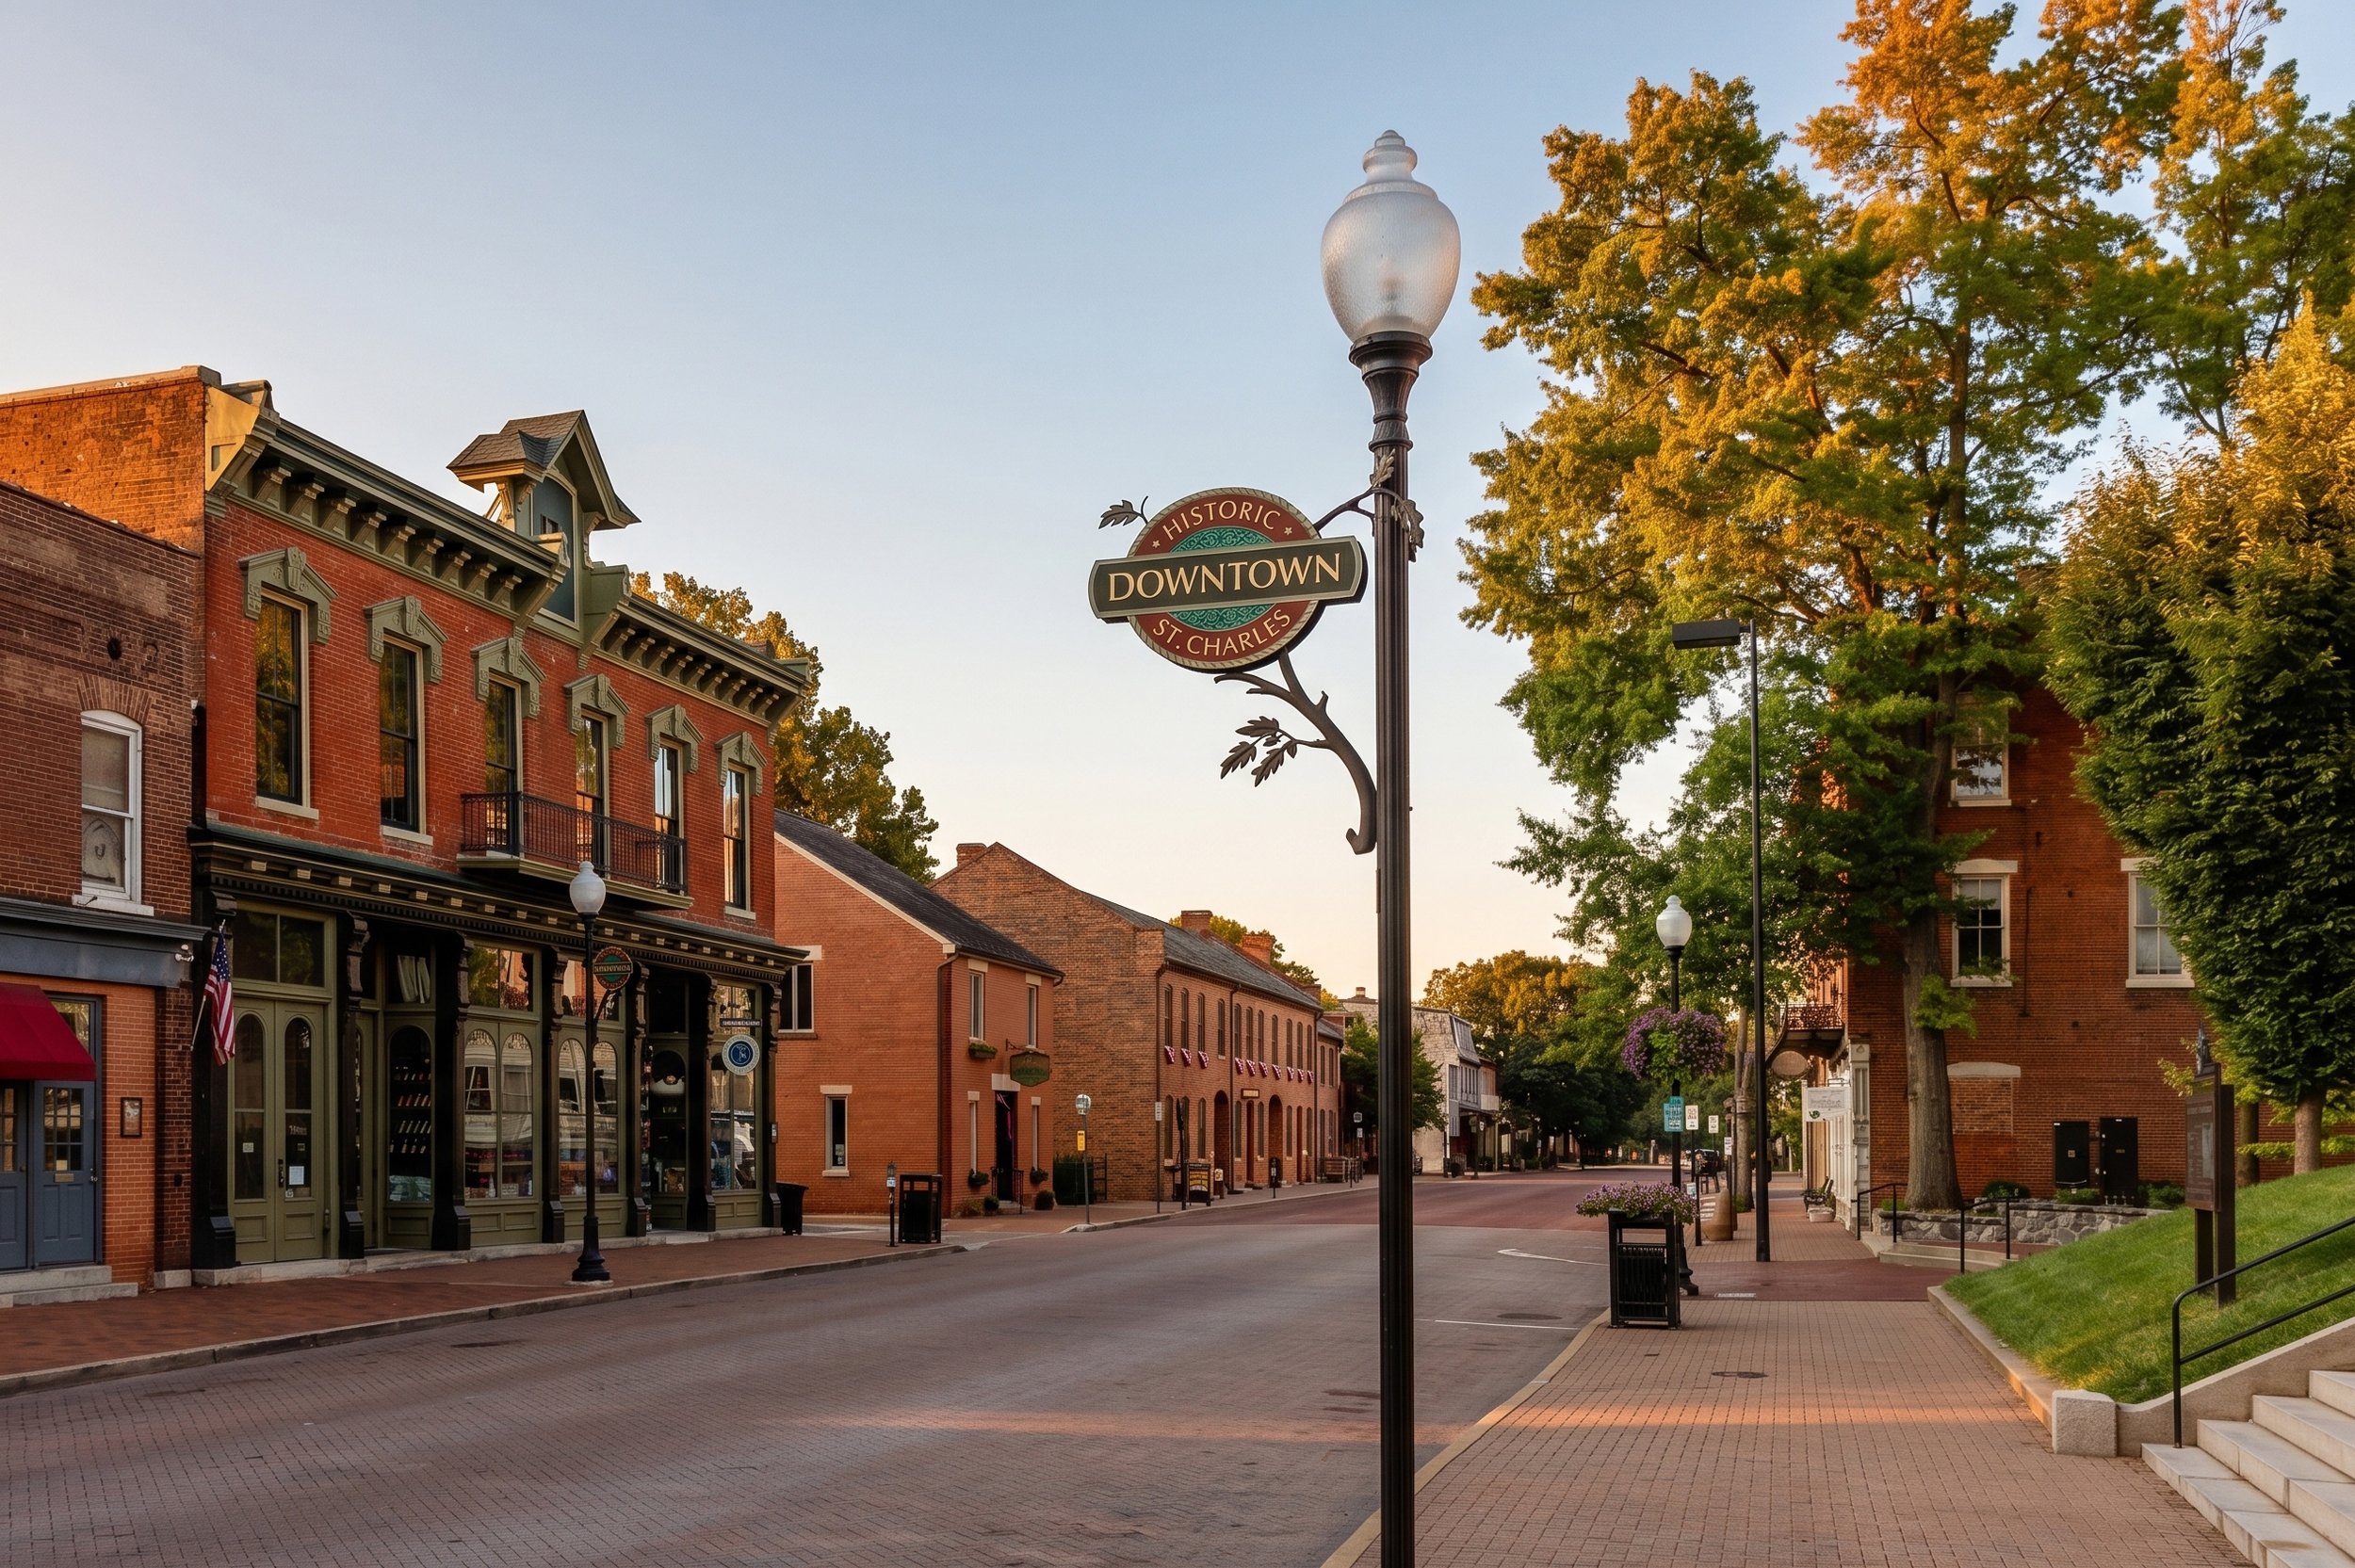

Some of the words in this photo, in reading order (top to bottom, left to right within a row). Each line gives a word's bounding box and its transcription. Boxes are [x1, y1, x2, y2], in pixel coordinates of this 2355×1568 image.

[1162, 500, 1280, 541] HISTORIC
[1108, 553, 1340, 602] DOWNTOWN
[1152, 619, 1182, 650] ST.
[1186, 609, 1291, 656] CHARLES
